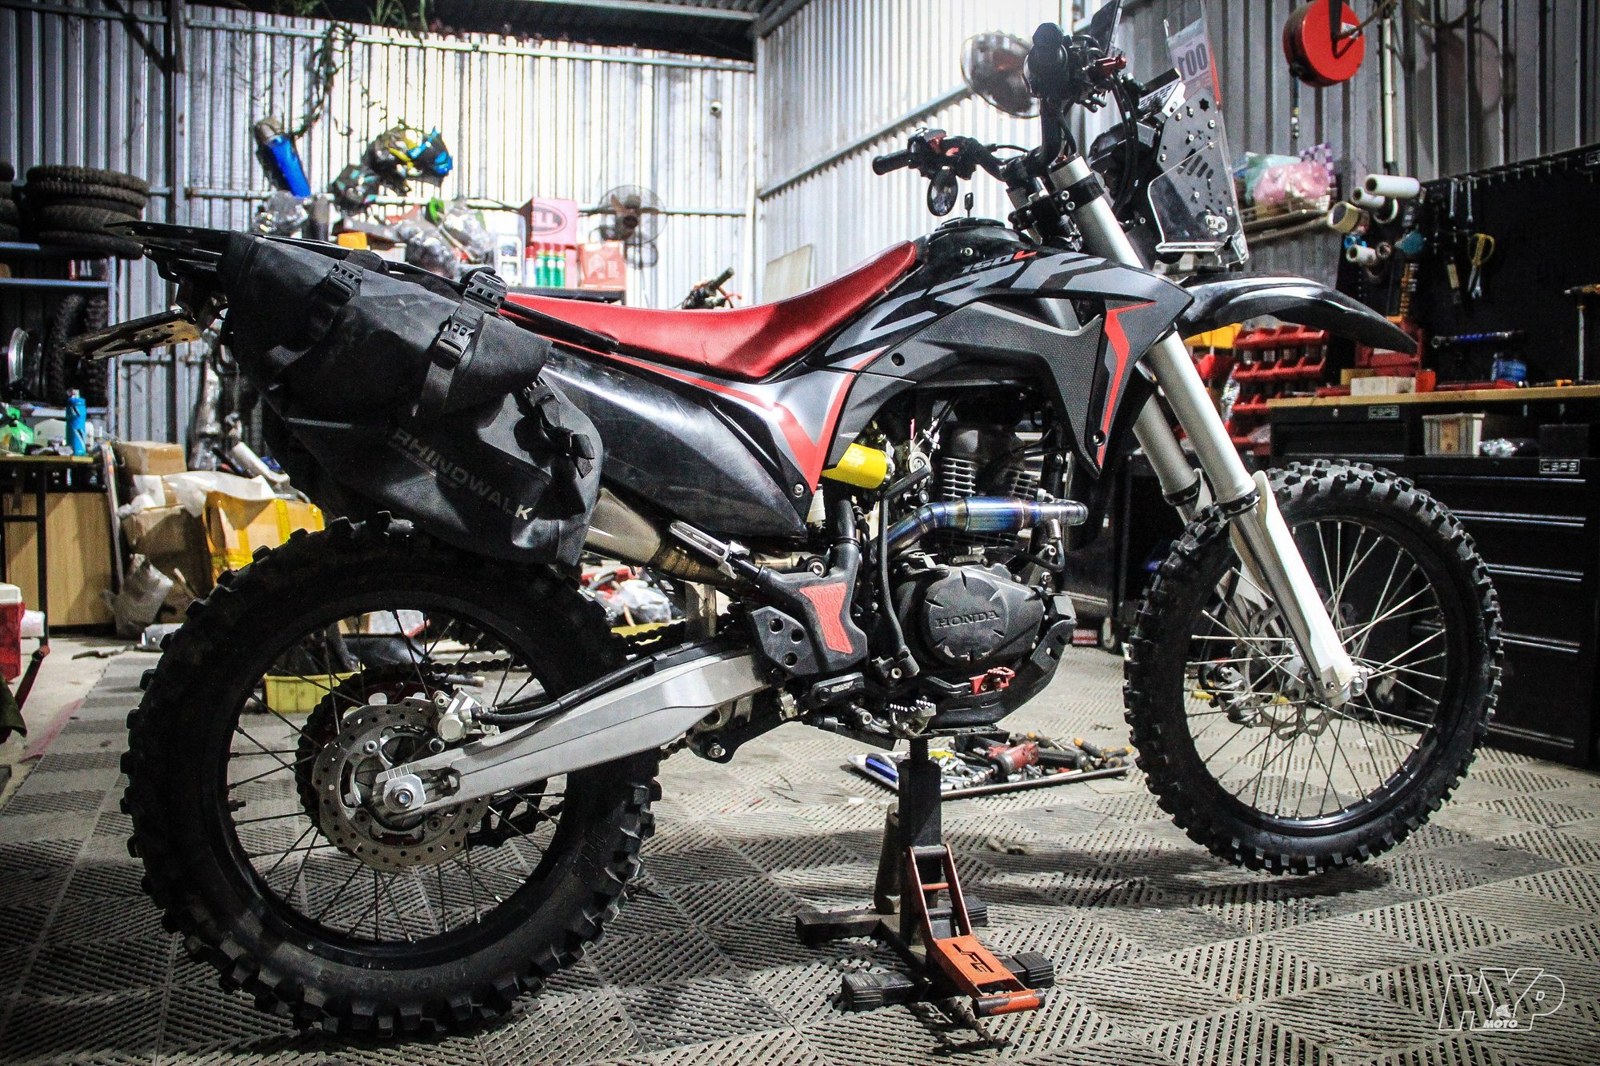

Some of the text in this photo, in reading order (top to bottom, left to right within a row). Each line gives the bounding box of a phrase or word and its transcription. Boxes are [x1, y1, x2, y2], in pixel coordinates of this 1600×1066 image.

[961, 250, 1038, 274] 150L
[391, 427, 533, 521] RHINOWALK
[1542, 461, 1577, 472] CSPS
[935, 610, 1000, 629] HONDA
